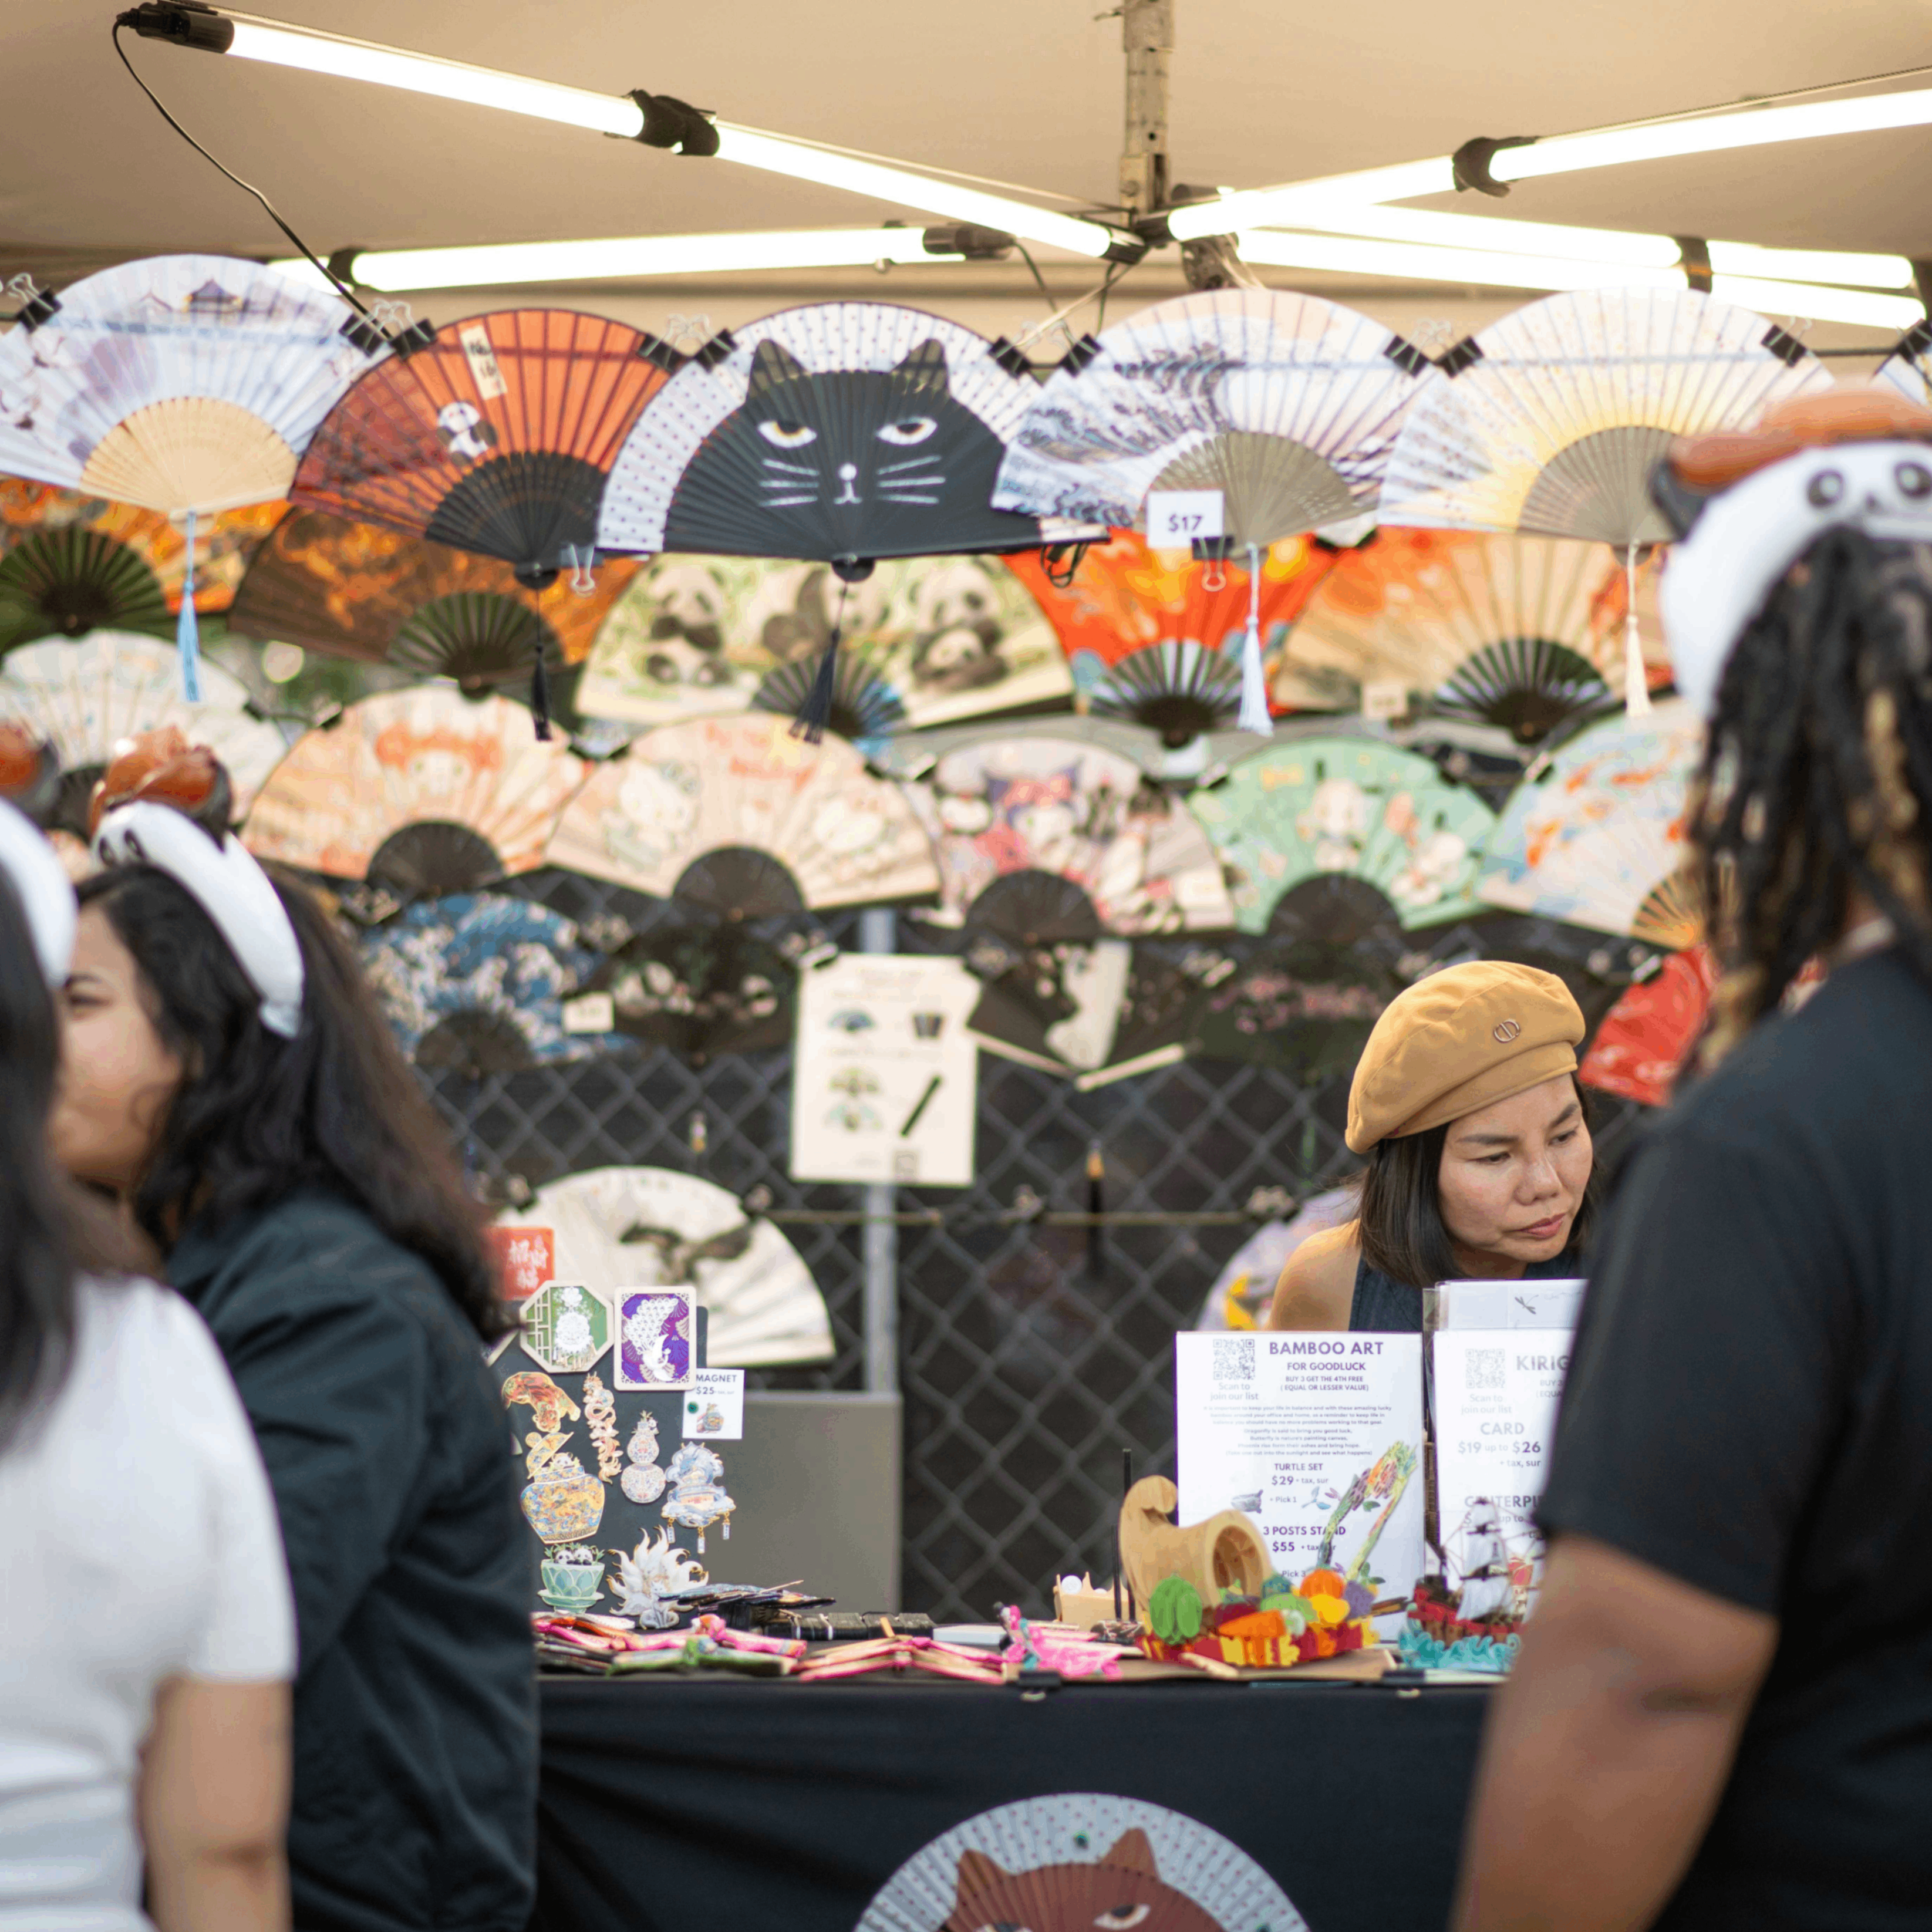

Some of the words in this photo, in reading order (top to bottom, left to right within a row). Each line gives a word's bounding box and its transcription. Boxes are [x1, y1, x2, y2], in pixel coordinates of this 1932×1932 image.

[1168, 513, 1203, 532] $17
[1269, 1341, 1345, 1355] BAMBOO
[1351, 1341, 1384, 1355] ART
[1287, 1362, 1307, 1371] FOR
[1309, 1362, 1366, 1371] GOODLUCK
[696, 1374, 737, 1383] MAGNET
[696, 1386, 714, 1395] $25
[1210, 1392, 1226, 1401] join
[1245, 1392, 1259, 1400] list
[1470, 1394, 1492, 1402] Scan
[1461, 1406, 1479, 1415] join
[1498, 1405, 1512, 1414] list
[1480, 1422, 1525, 1435] CARD
[1458, 1441, 1482, 1454] $19
[1512, 1441, 1541, 1454] $26
[1507, 1459, 1524, 1468] tax,
[1272, 1475, 1294, 1486] $29
[1263, 1526, 1269, 1535] 3
[1272, 1526, 1307, 1535] POSTS
[1272, 1540, 1295, 1553] $55
